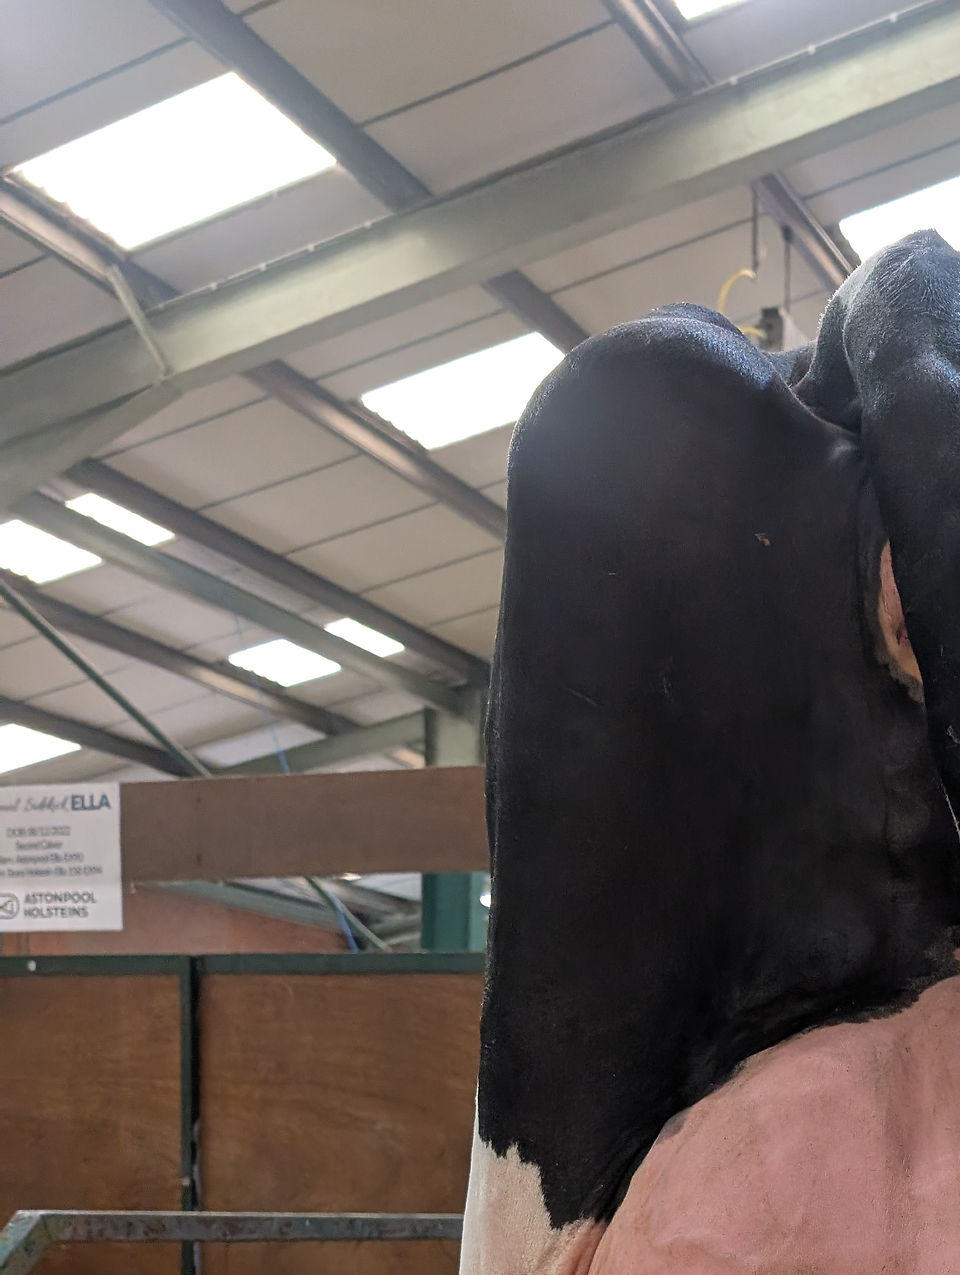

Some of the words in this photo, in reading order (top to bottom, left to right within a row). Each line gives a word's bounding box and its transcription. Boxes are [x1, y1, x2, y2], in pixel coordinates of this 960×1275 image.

[71, 793, 111, 811] ELLA
[24, 891, 97, 904] ASTONPOOL
[24, 906, 88, 919] HOLSTEINS
